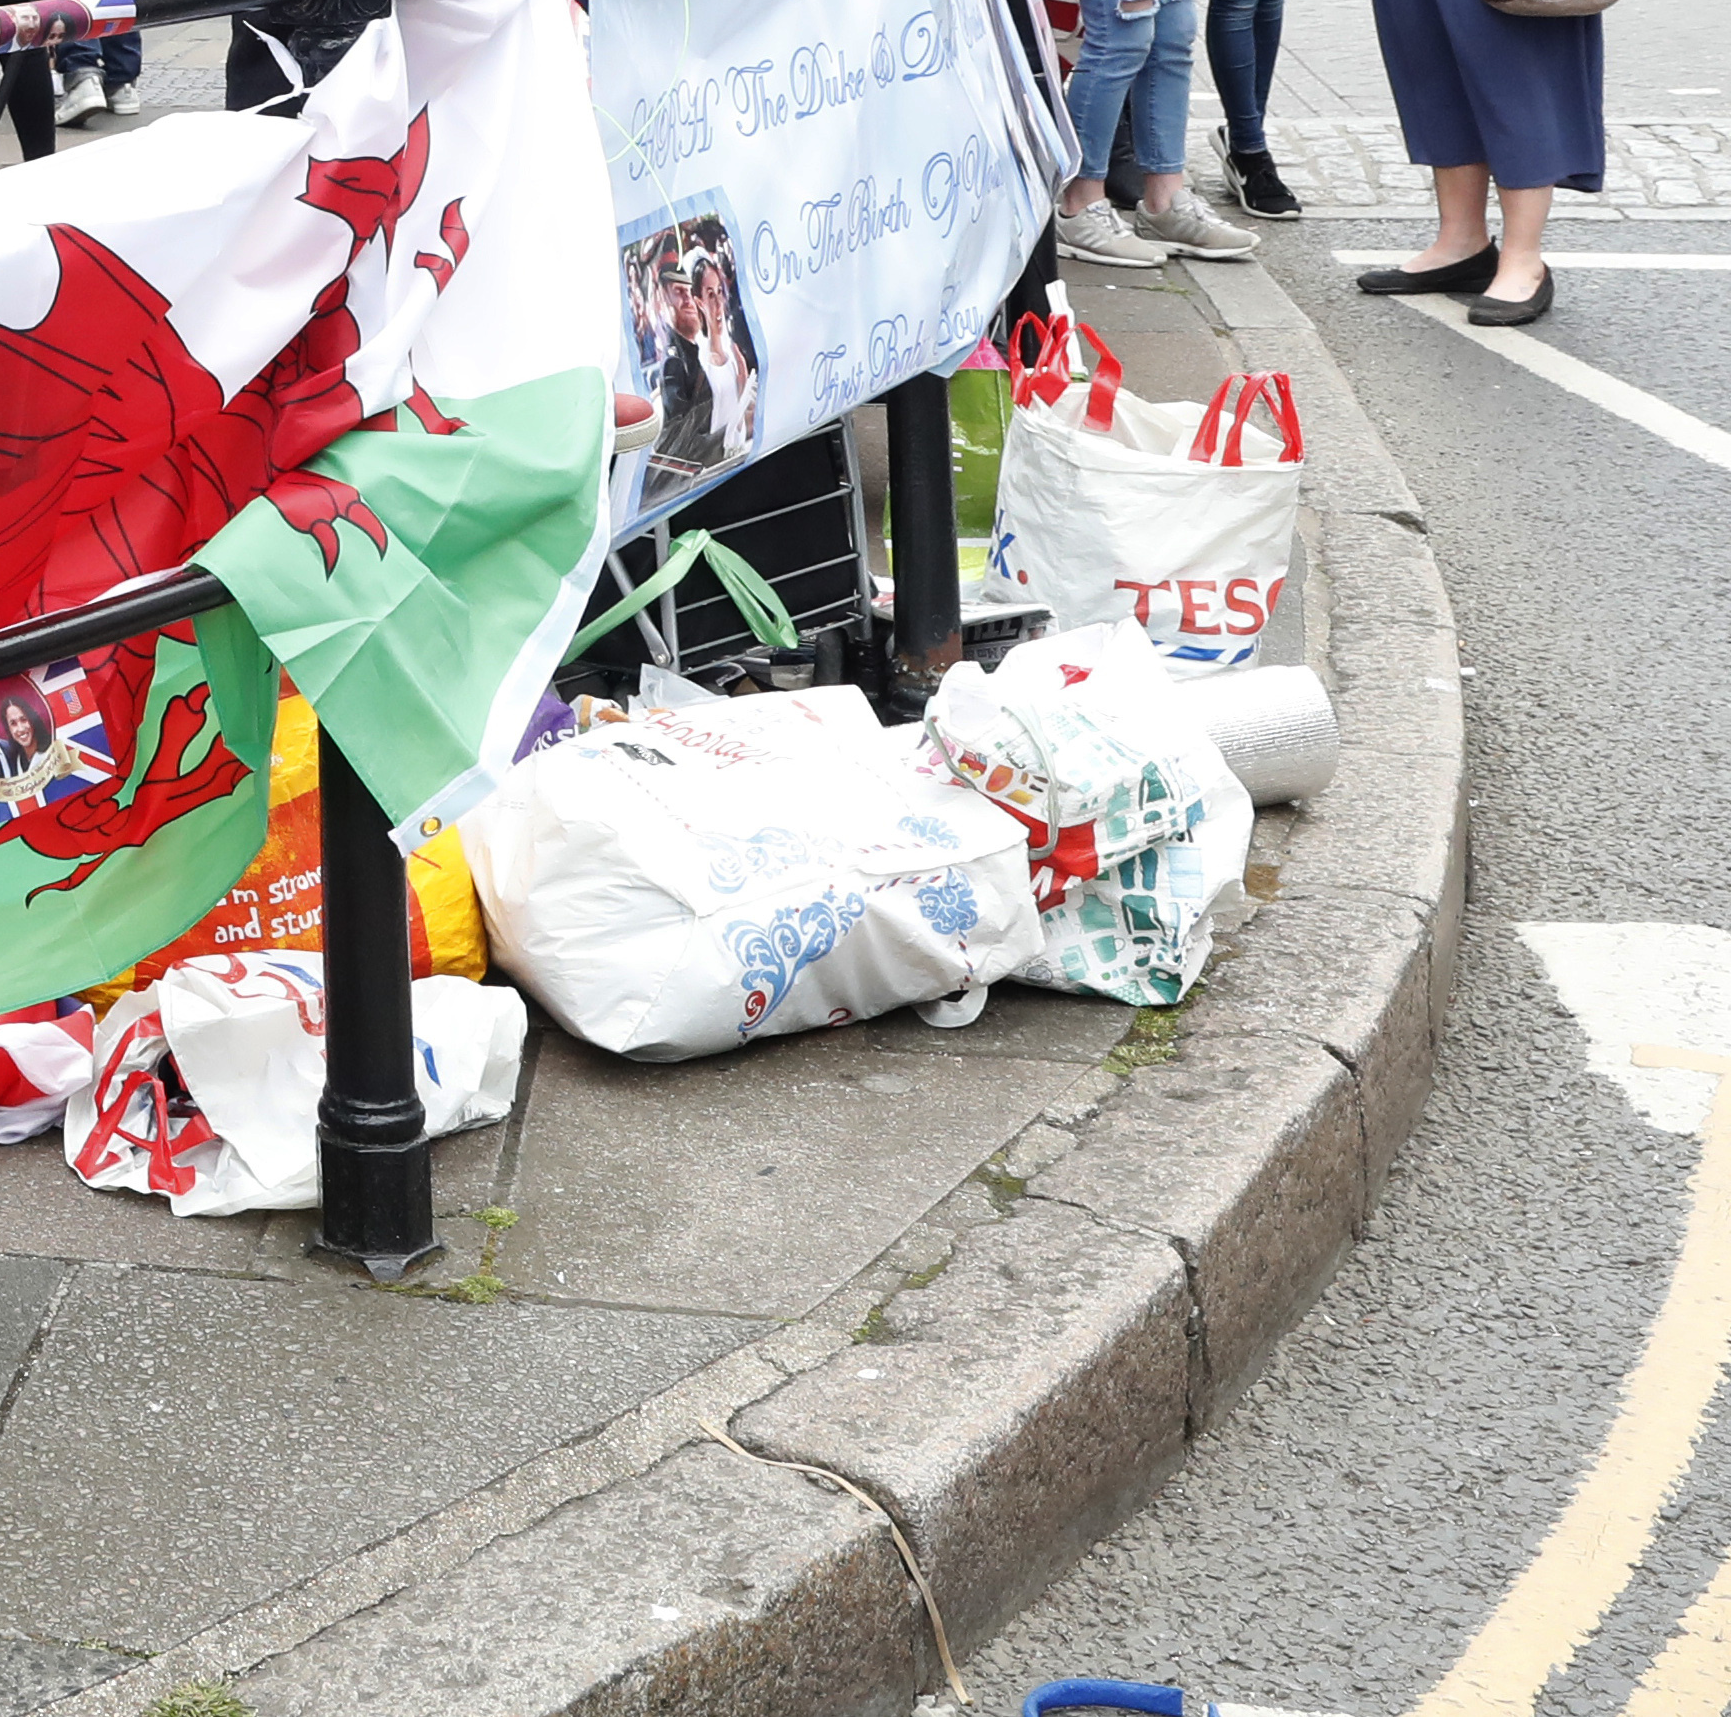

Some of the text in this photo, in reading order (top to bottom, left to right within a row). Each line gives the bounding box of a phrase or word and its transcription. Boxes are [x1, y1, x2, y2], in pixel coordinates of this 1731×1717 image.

[725, 59, 788, 136] The
[789, 41, 865, 120] Duke
[751, 219, 803, 295] On
[800, 192, 843, 274] The
[847, 174, 912, 253] Birth
[922, 151, 962, 239] Of
[808, 343, 865, 425] First
[869, 313, 931, 393] Bab
[214, 905, 322, 944] and stur
